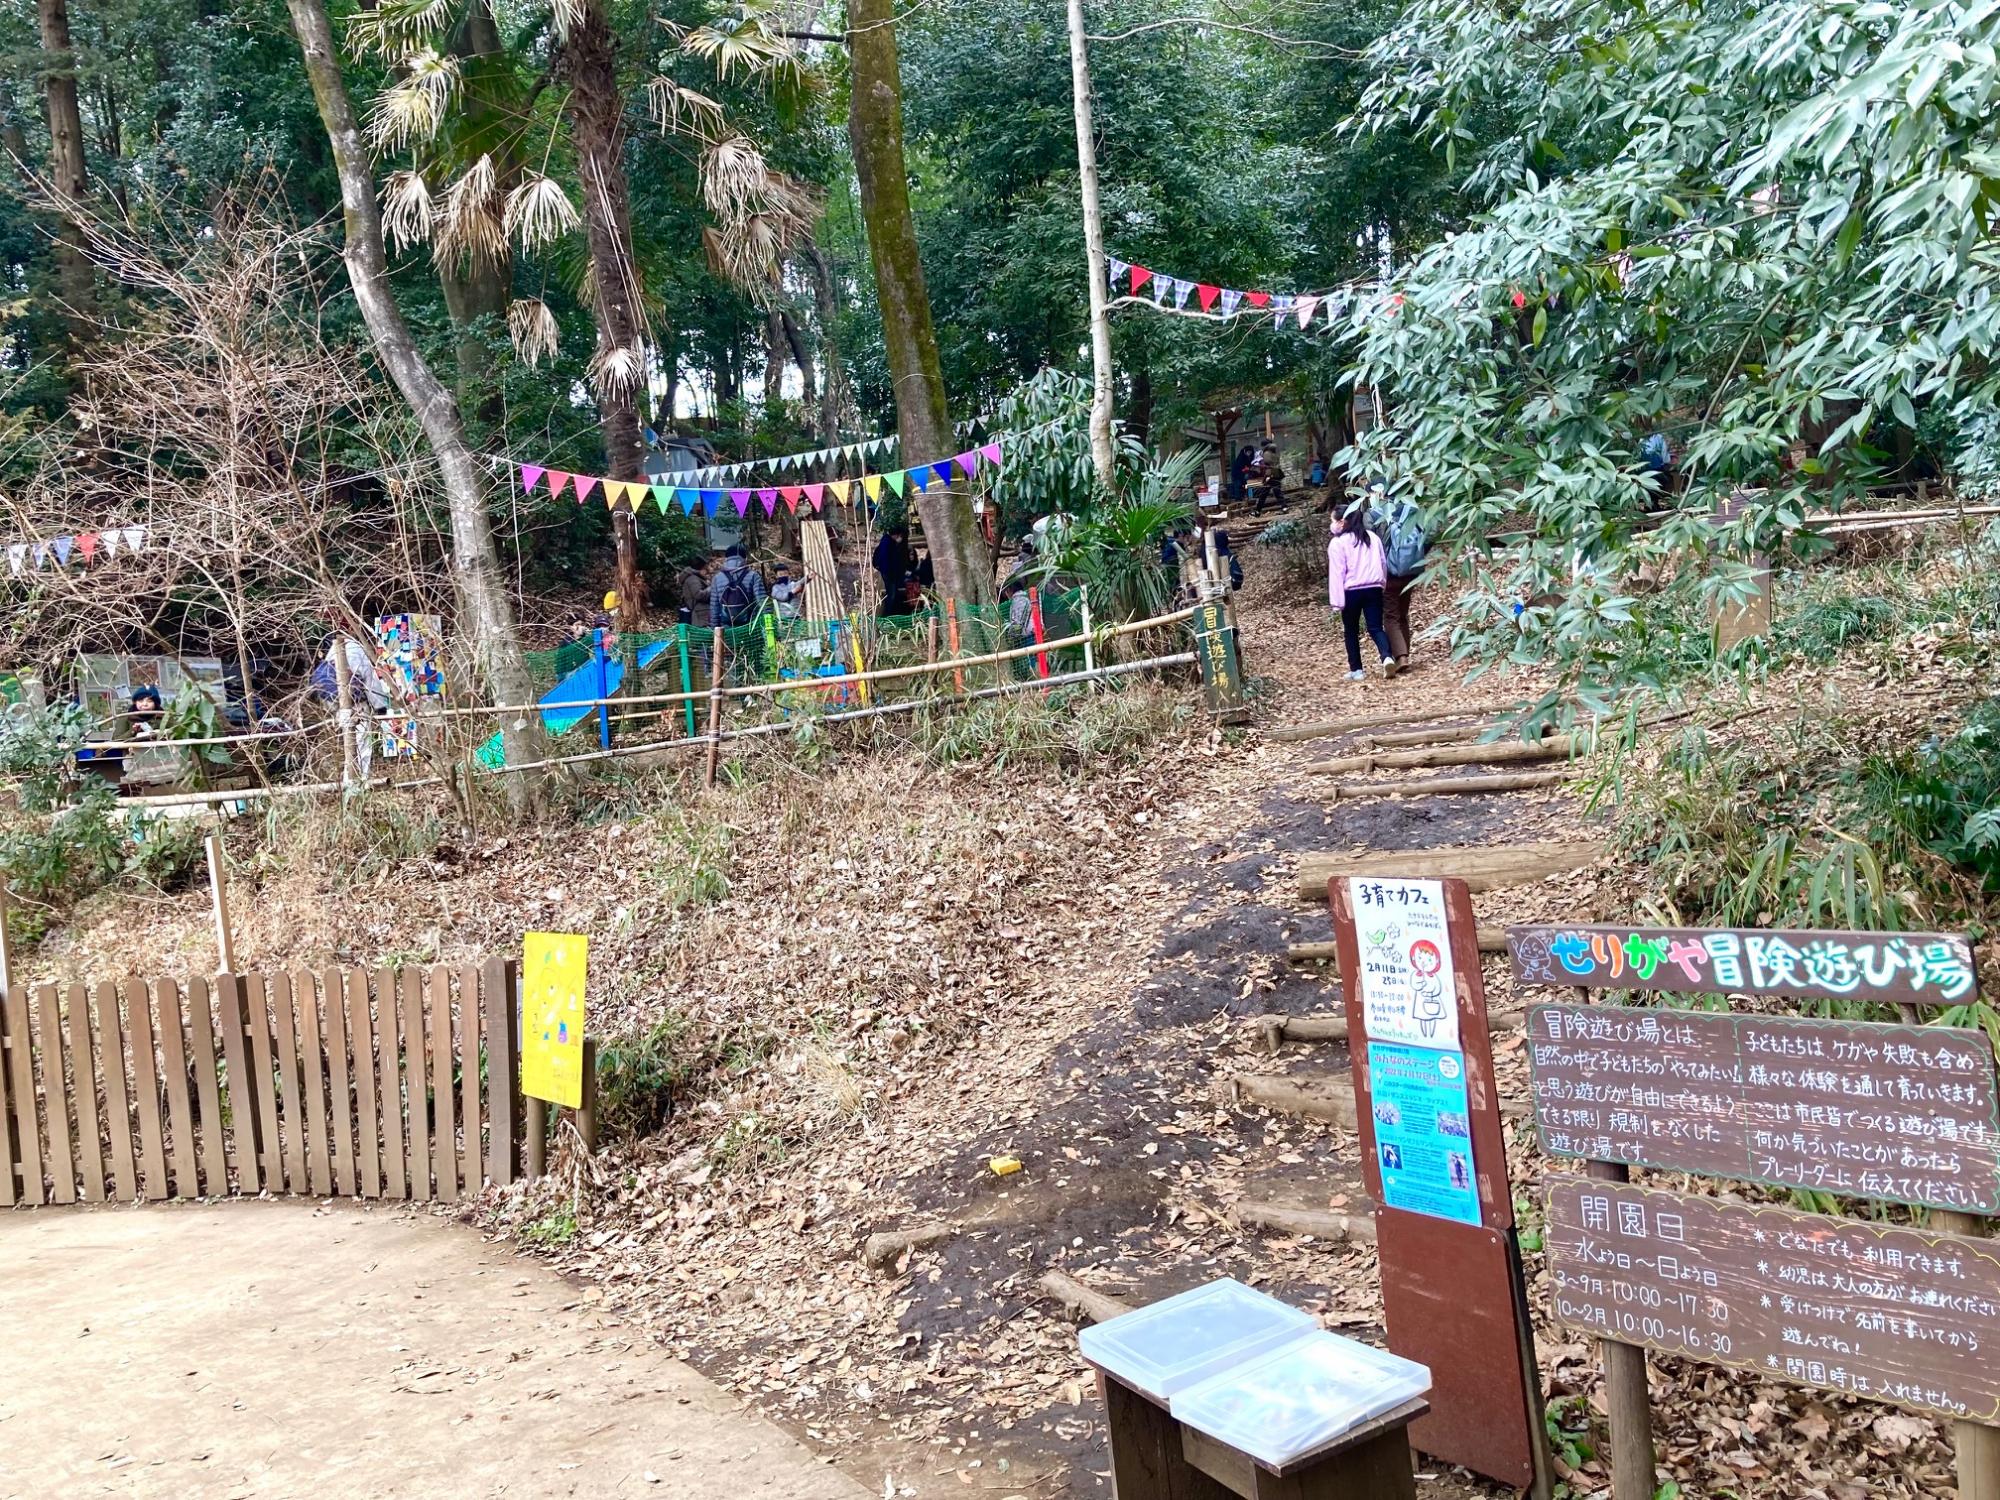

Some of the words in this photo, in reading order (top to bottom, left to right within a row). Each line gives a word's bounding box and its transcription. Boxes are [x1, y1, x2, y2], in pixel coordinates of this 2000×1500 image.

[1359, 882, 1430, 909] 子育てカフェ
[1550, 932, 1974, 1000] せりがや冒険遊び場
[1549, 1132, 1649, 1164] 遊び場です。
[1579, 1195, 1684, 1241] 開園日
